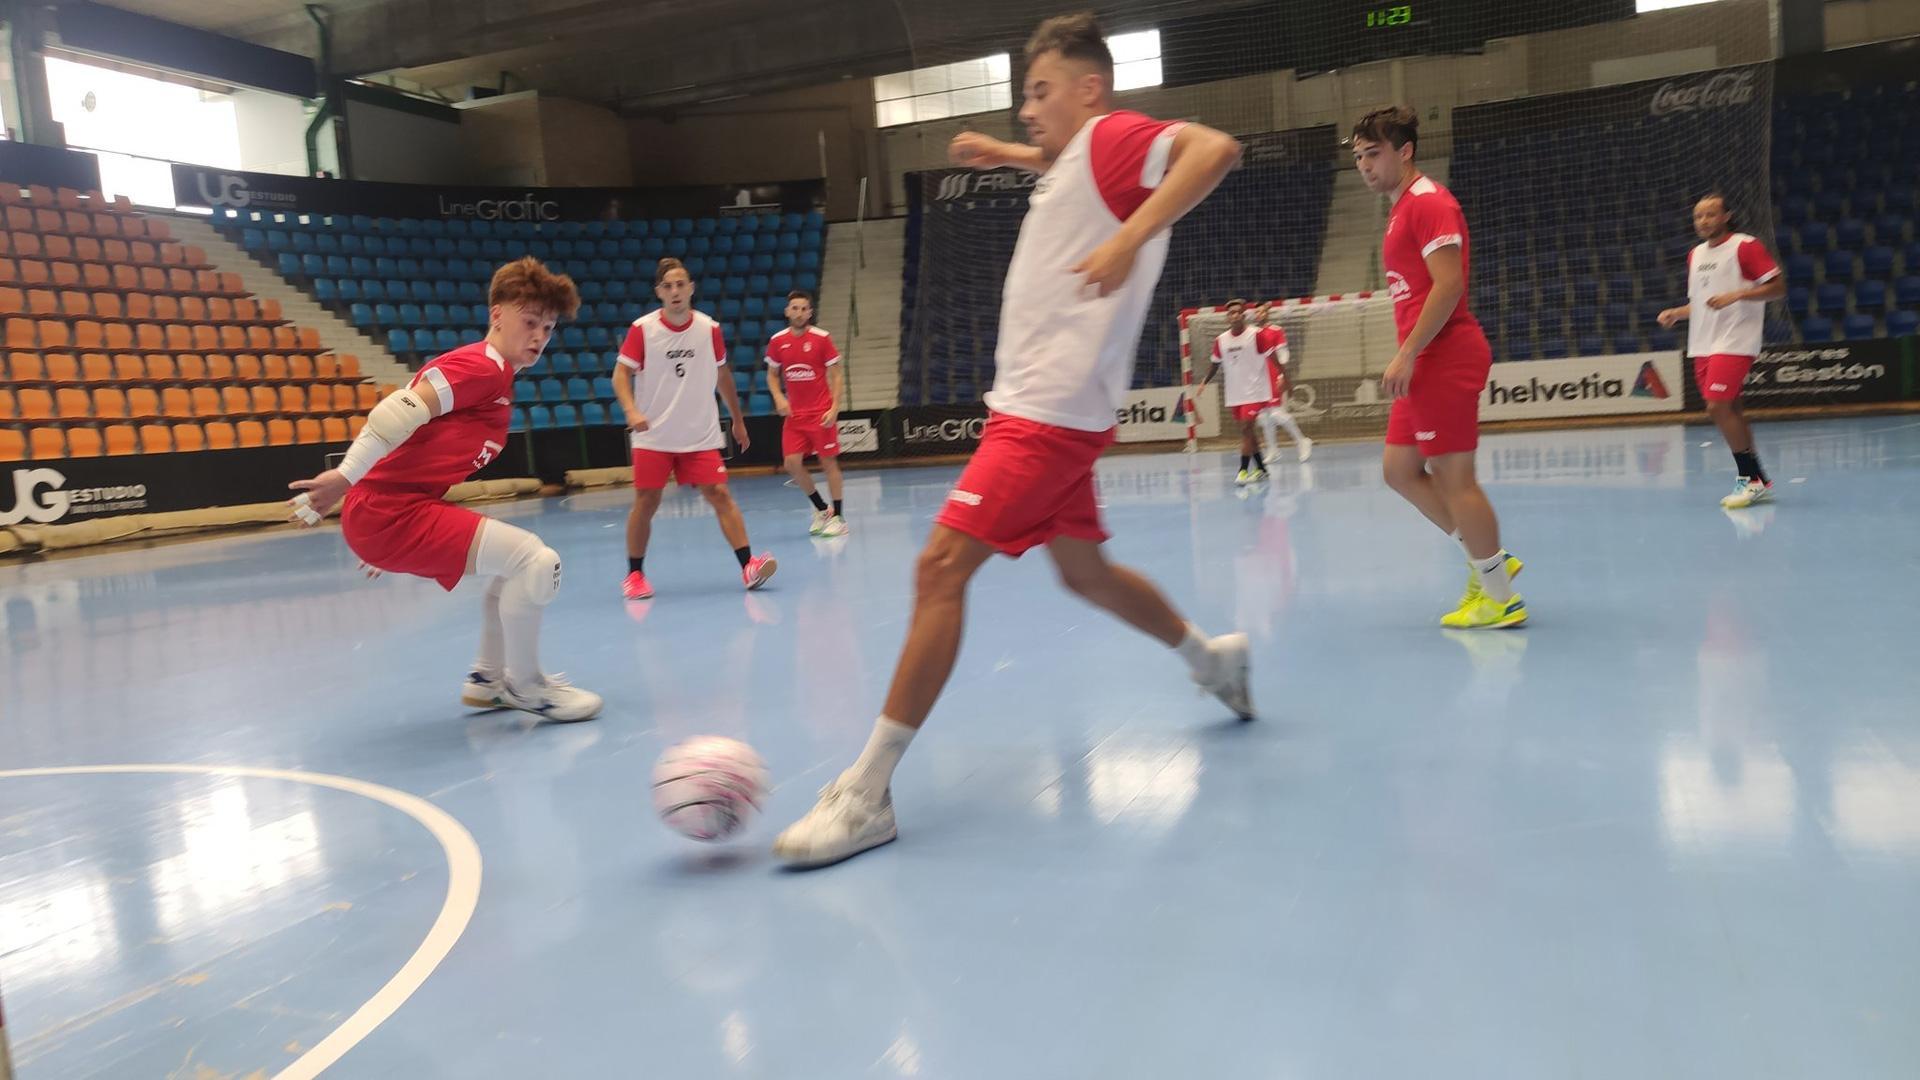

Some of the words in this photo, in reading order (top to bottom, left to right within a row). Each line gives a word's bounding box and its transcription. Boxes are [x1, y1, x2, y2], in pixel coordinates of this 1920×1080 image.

[197, 172, 250, 207] UG
[249, 190, 297, 203] ESTUDIO
[675, 362, 686, 378] 6
[1489, 372, 1623, 405] helvetia
[1115, 400, 1167, 425] etia
[67, 484, 147, 503] ESTUDIO
